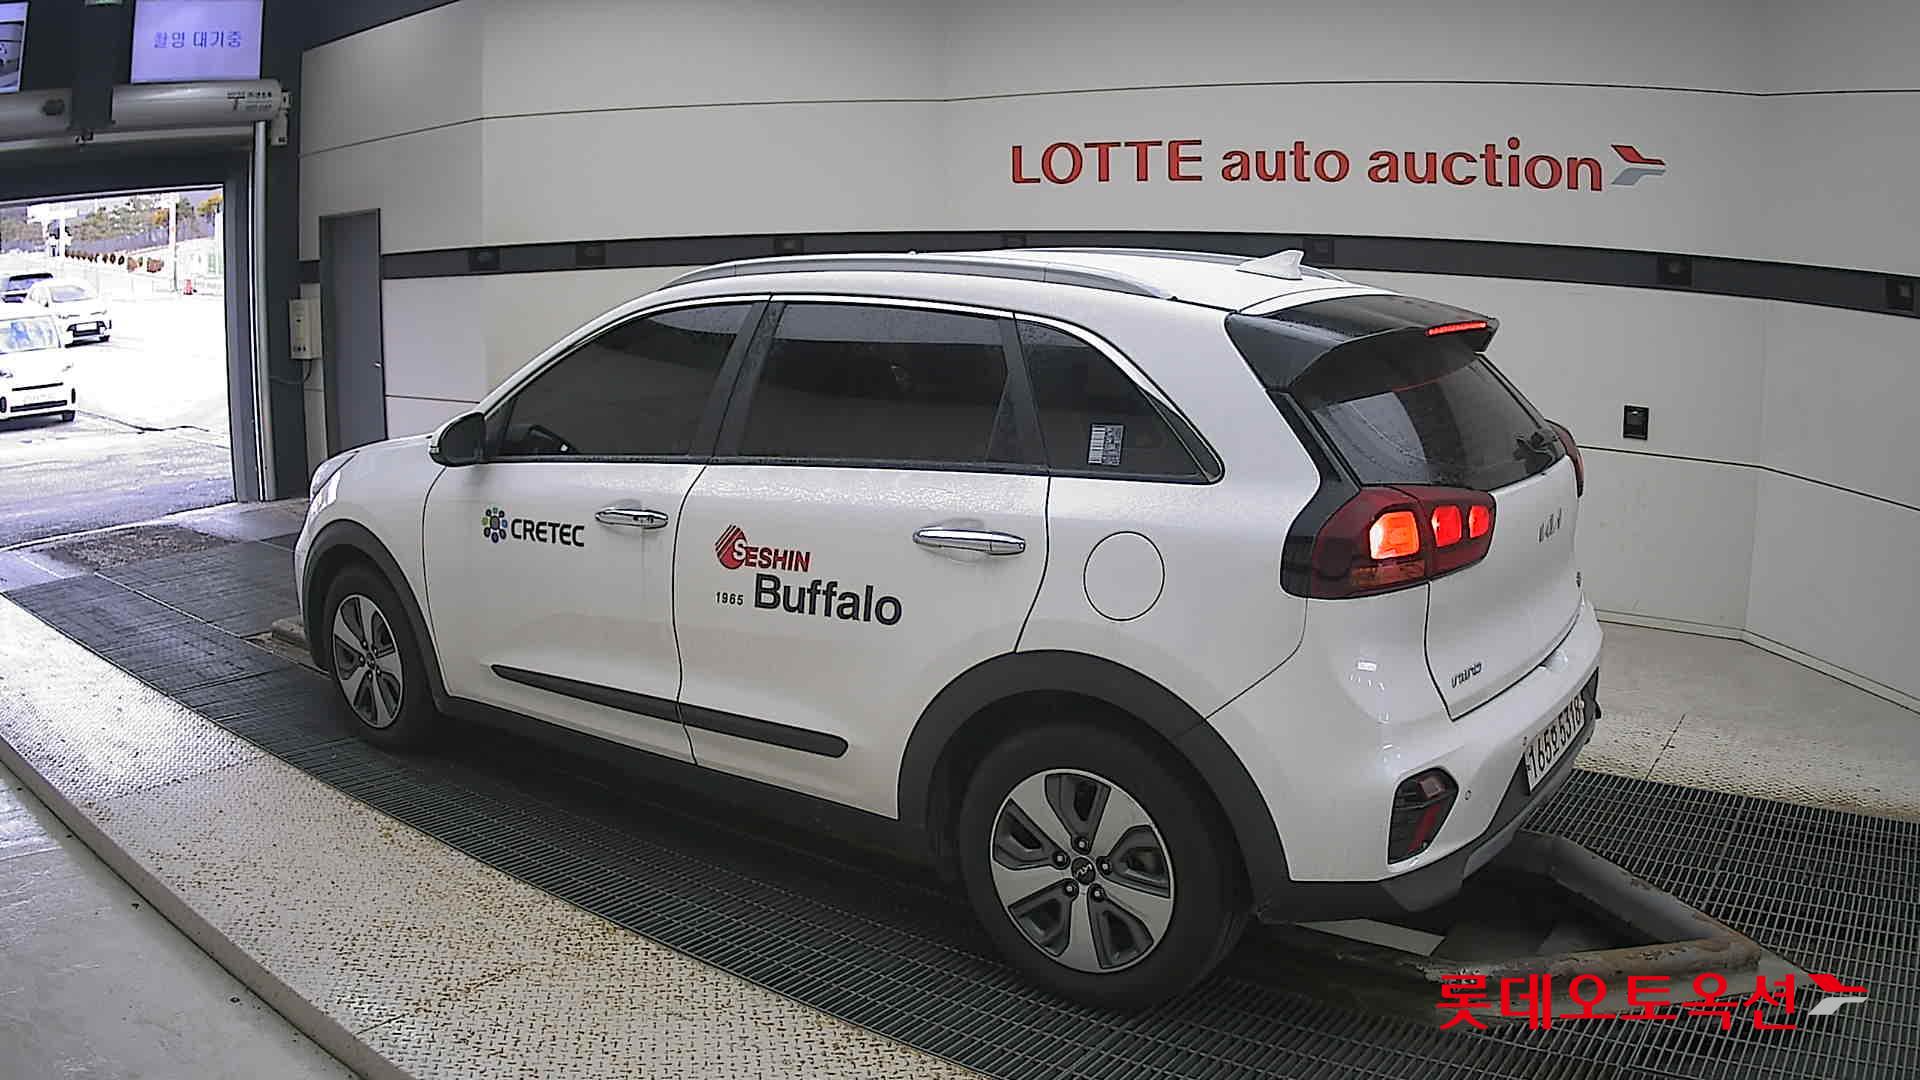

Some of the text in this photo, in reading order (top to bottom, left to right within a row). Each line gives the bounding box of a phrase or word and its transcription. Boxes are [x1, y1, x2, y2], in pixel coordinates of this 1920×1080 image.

[193, 31, 241, 48] 대기중
[1011, 137, 1603, 191] LOTTE auto auction
[511, 519, 585, 547] CRETEC
[732, 538, 811, 573] SESHIN
[715, 573, 902, 626] 1965 Buffalo
